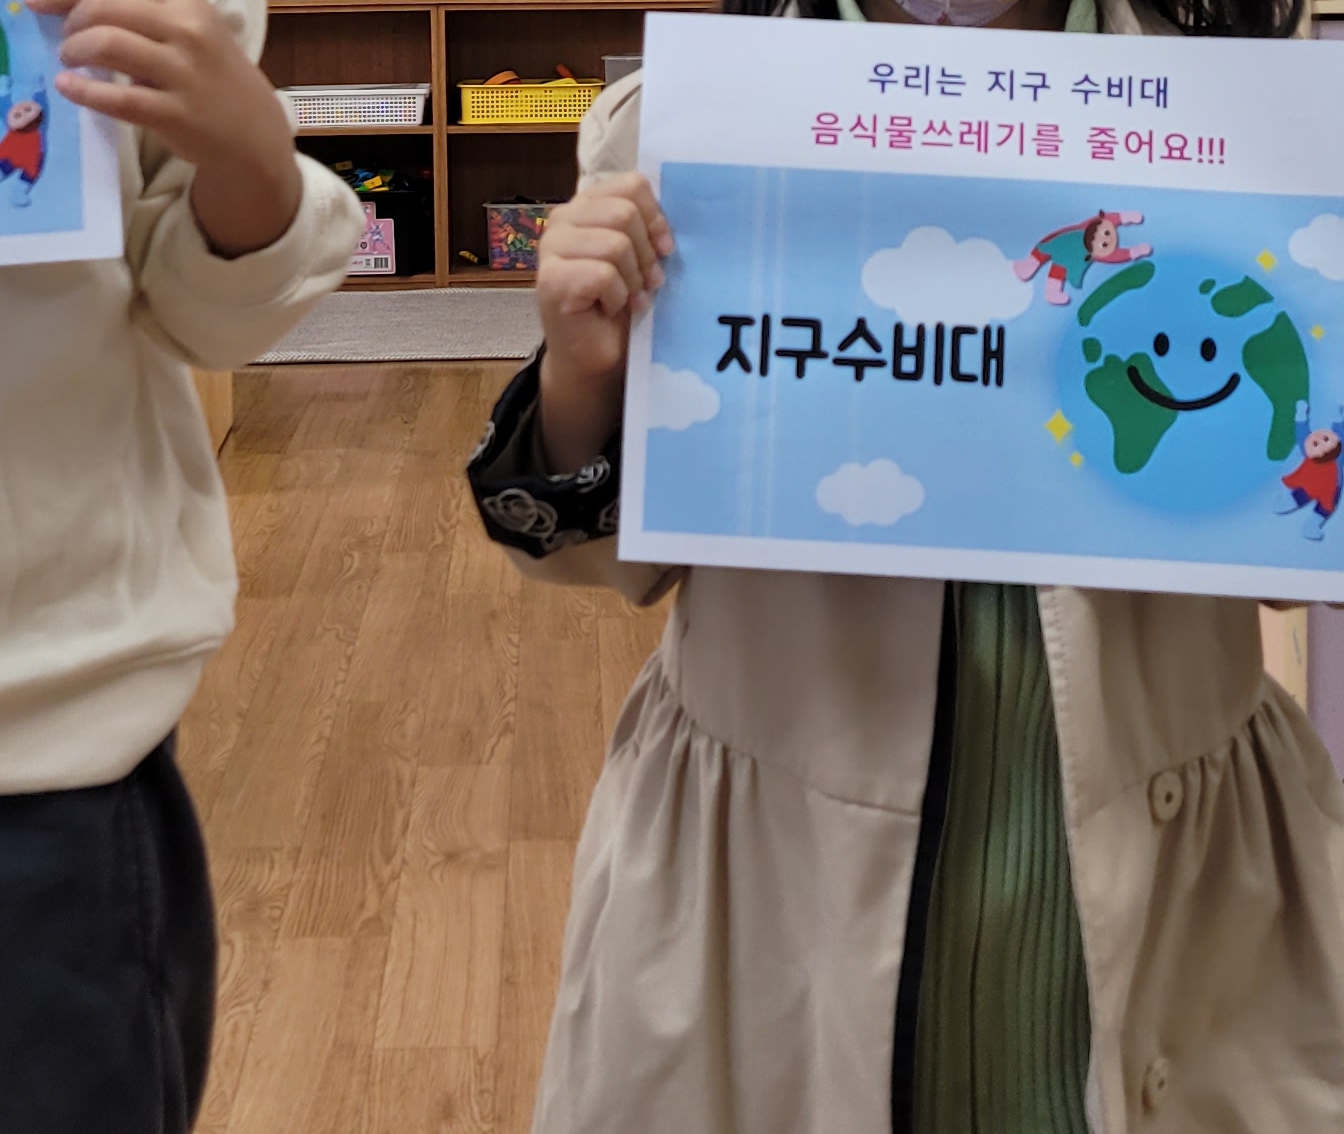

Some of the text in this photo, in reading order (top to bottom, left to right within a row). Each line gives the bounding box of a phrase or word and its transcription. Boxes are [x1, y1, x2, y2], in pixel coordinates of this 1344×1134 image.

[867, 63, 1170, 109] 우리는 지구 수비대
[811, 113, 1227, 166] 음식물쓰레기를 줄어요!!!
[717, 314, 1006, 389] 지구수비대
